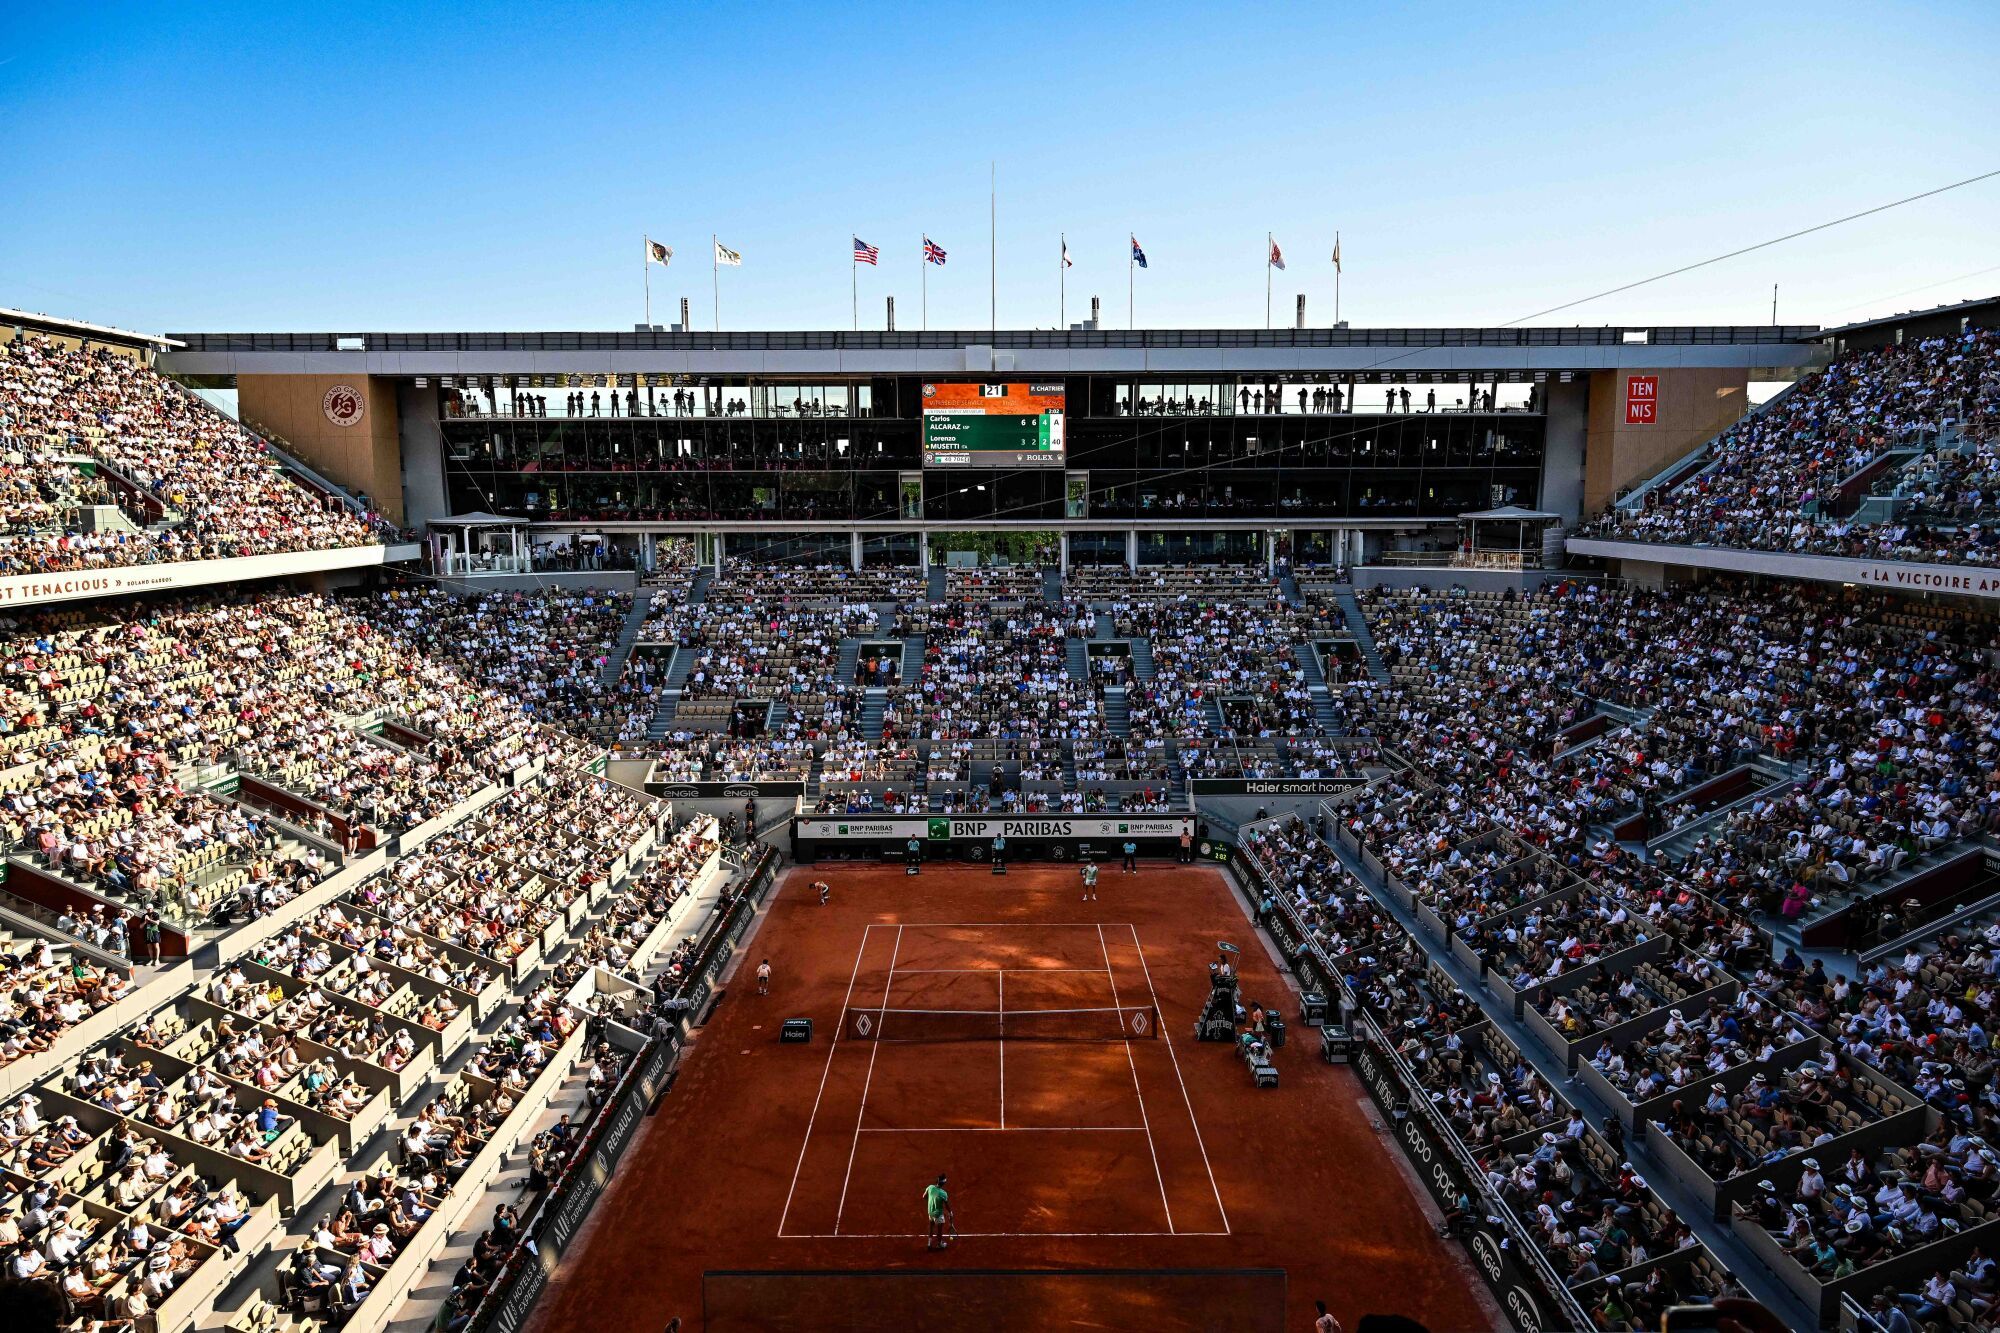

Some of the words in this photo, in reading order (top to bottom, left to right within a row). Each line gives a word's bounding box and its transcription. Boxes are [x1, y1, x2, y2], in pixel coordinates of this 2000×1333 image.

[325, 387, 341, 410] ROLAND
[344, 386, 362, 410] GARROS
[986, 386, 999, 395] 21
[1632, 383, 1653, 395] TEN
[1631, 405, 1651, 417] NIS
[22, 579, 108, 598] TENACIOUS
[1874, 569, 1889, 581] LA
[1897, 572, 1971, 589] VICTOIRE
[1979, 579, 2000, 591] AP
[218, 780, 238, 793] PARIBAS
[1247, 783, 1280, 793] Haier
[1283, 783, 1316, 792] smart
[1319, 782, 1352, 792] home
[954, 823, 987, 835] BNP
[1004, 822, 1072, 836] PARIBAS
[1271, 916, 1284, 936] oppo
[704, 960, 718, 986] oppo
[690, 984, 704, 1010] oppo
[641, 1054, 664, 1095] RENAULT
[606, 1105, 635, 1154] RENAULT
[1406, 1122, 1431, 1162] oppo
[566, 1185, 583, 1213] HOTELS
[571, 1178, 597, 1224] EXPERIENCES
[513, 1268, 533, 1302] HOTELS
[518, 1259, 551, 1314] EXPERIENCES
